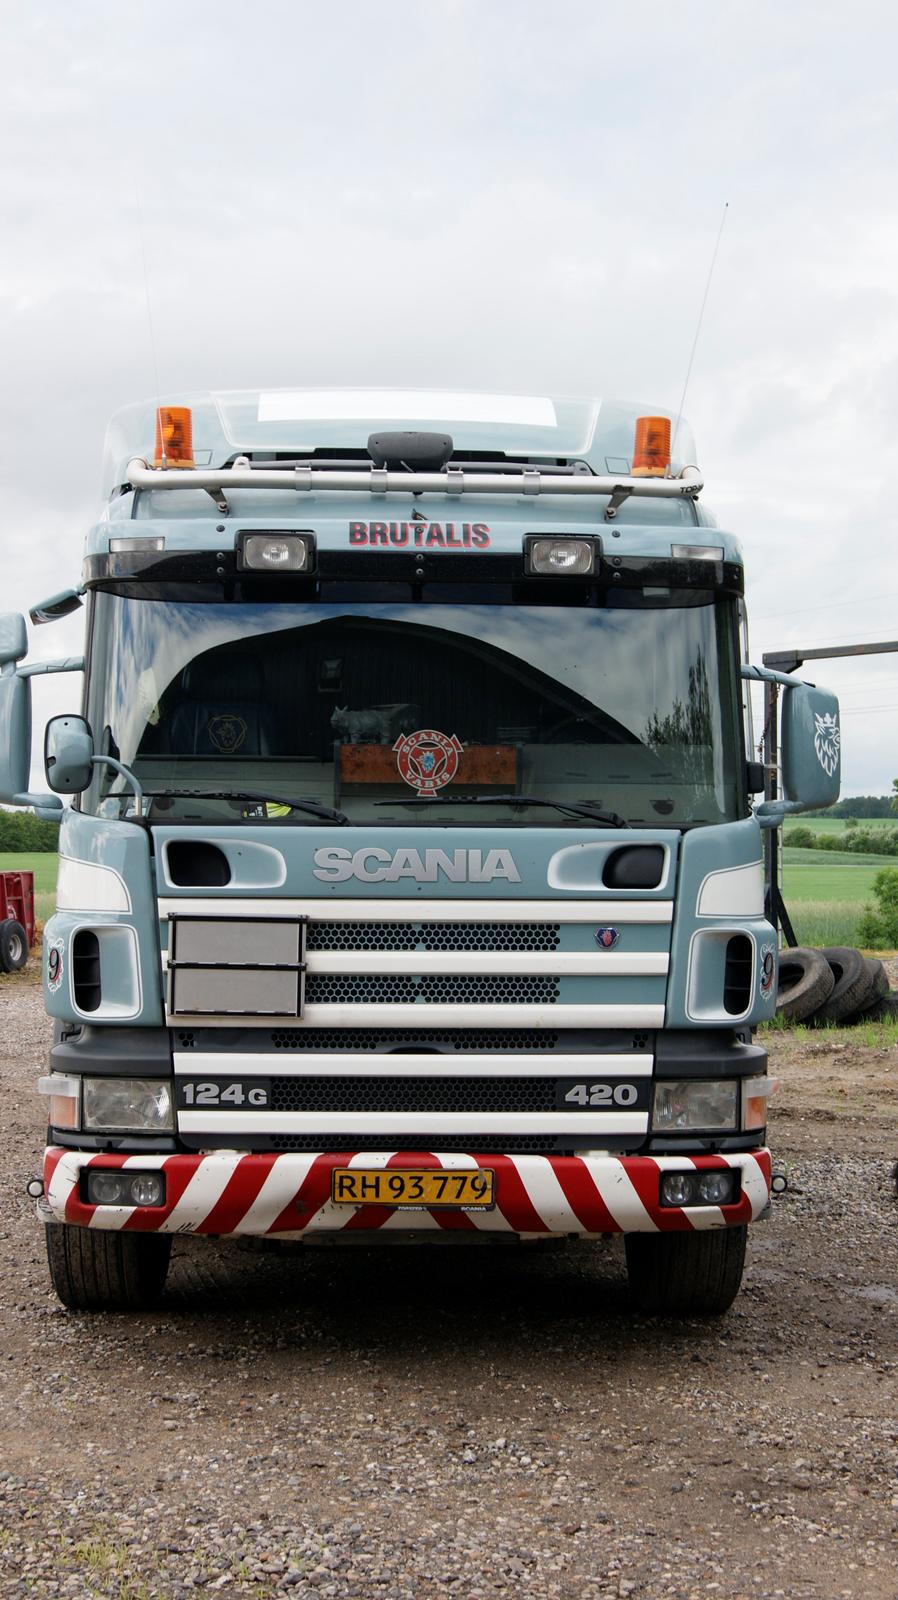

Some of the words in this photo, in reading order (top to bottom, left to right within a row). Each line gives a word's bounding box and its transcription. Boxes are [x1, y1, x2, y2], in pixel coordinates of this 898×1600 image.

[349, 521, 491, 548] BRUTALIS
[402, 732, 454, 756] SCANIA
[406, 770, 450, 788] VABIS
[313, 847, 522, 883] SCANIA
[565, 1084, 638, 1105] 420
